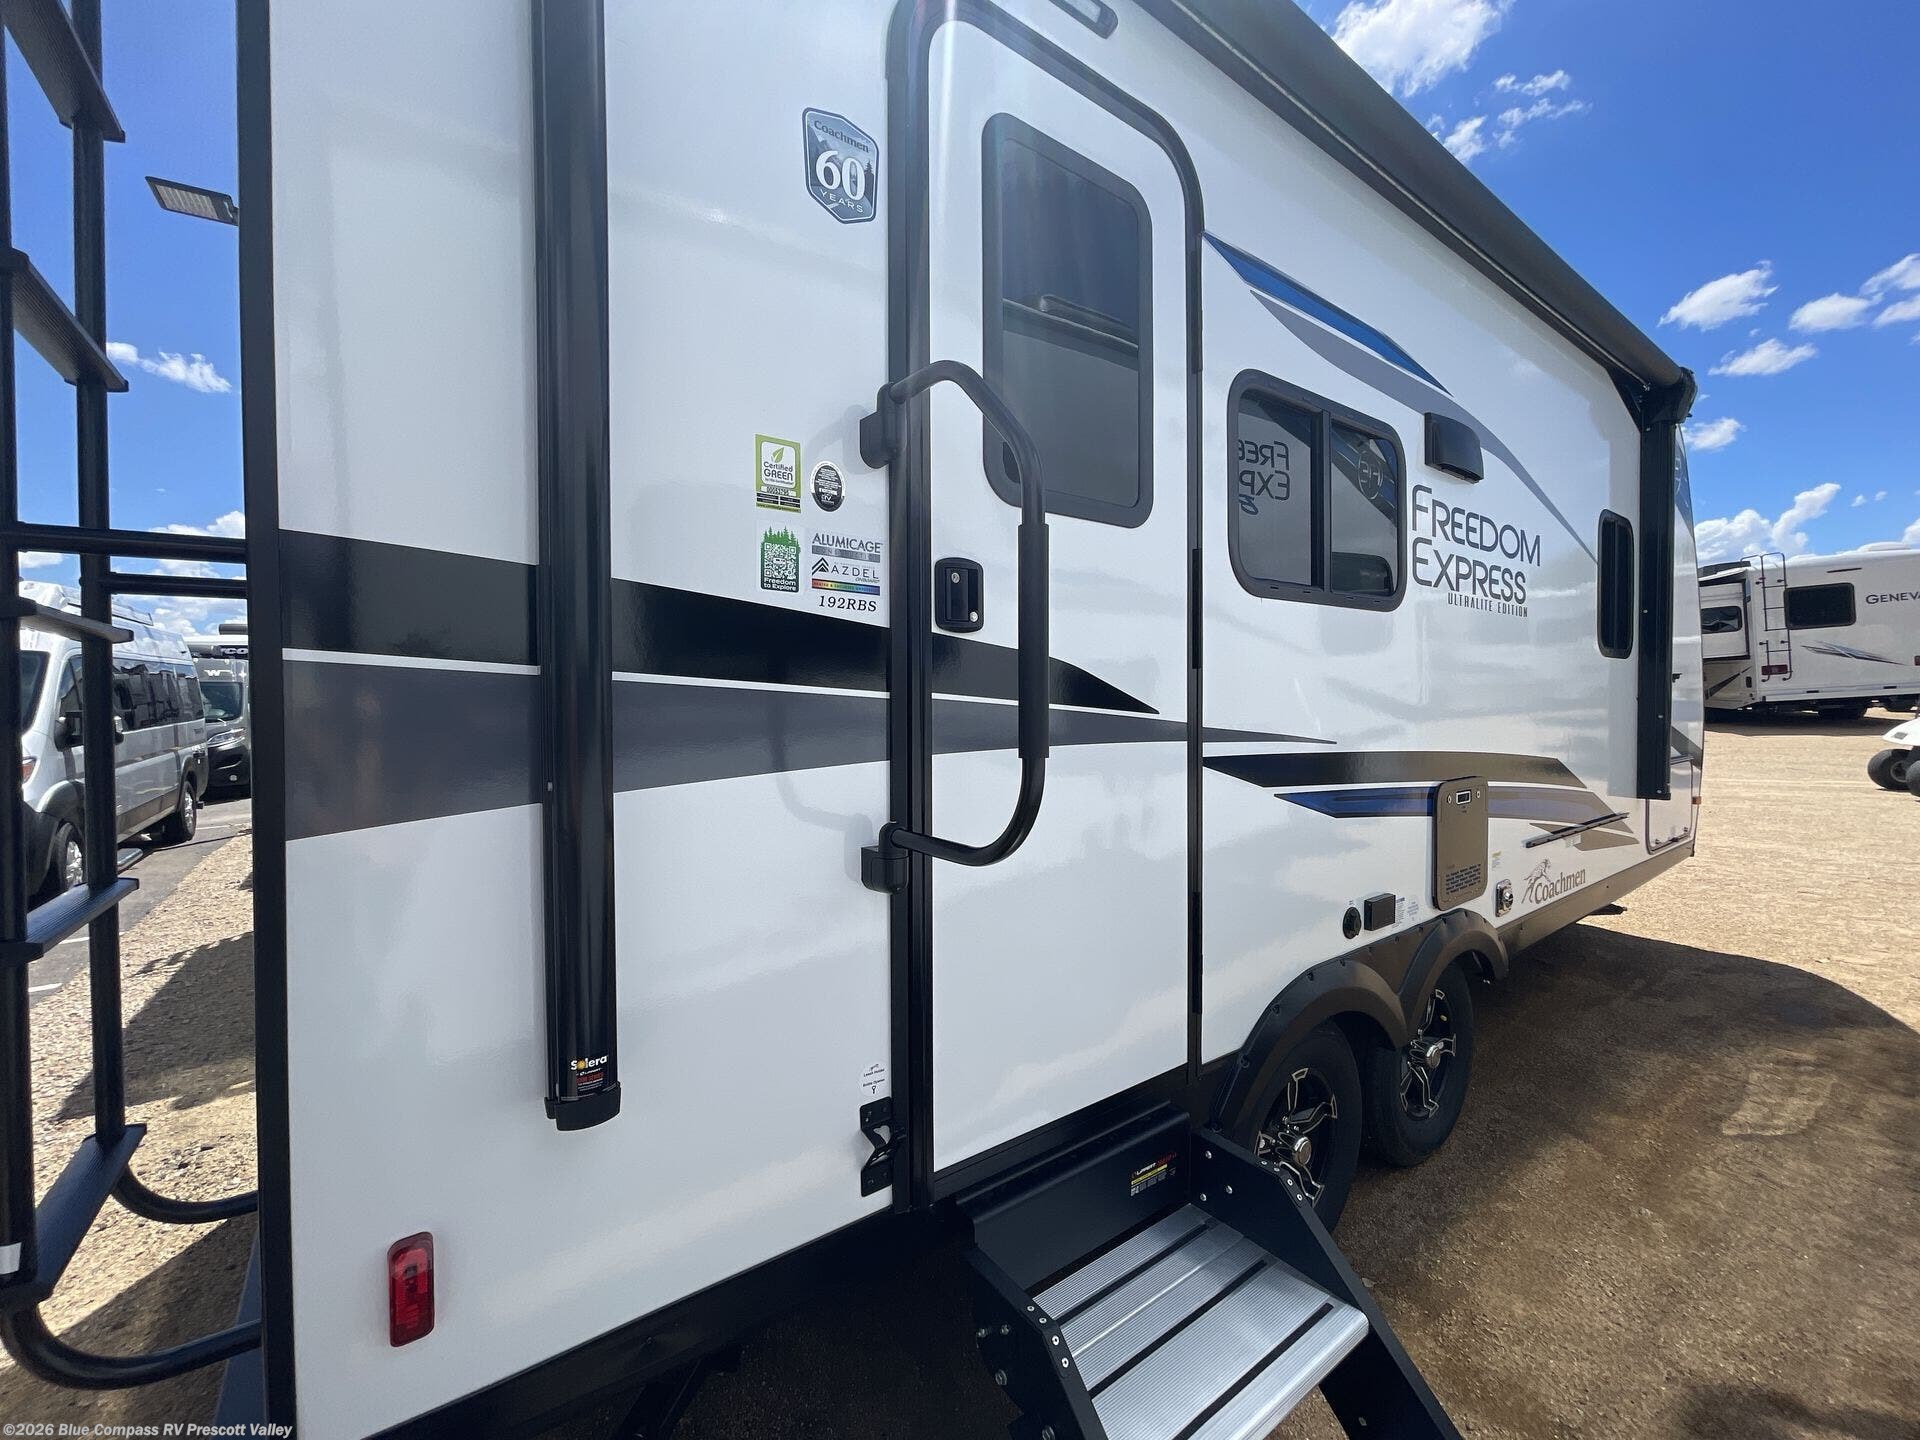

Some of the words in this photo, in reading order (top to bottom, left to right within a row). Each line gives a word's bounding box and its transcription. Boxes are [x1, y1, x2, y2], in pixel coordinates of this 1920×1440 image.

[814, 120, 869, 153] Coachmen
[816, 150, 866, 201] 60
[820, 189, 864, 213] YEARS
[763, 461, 793, 473] Certified
[763, 468, 793, 481] GREEN
[1412, 484, 1541, 567] FREEDOM
[812, 532, 882, 554] ALUMICAGE
[831, 564, 879, 580] AZDEL
[1412, 536, 1526, 605] EXPRESS
[764, 577, 796, 587] Freedom
[772, 582, 797, 592] Explore
[818, 595, 877, 612] 192RBS
[1448, 592, 1493, 612] ULTRALITE
[1497, 602, 1528, 618] EDITION
[1865, 591, 1920, 605] GENEV
[1534, 868, 1586, 905] Coachmen
[570, 1055, 608, 1071] Solera
